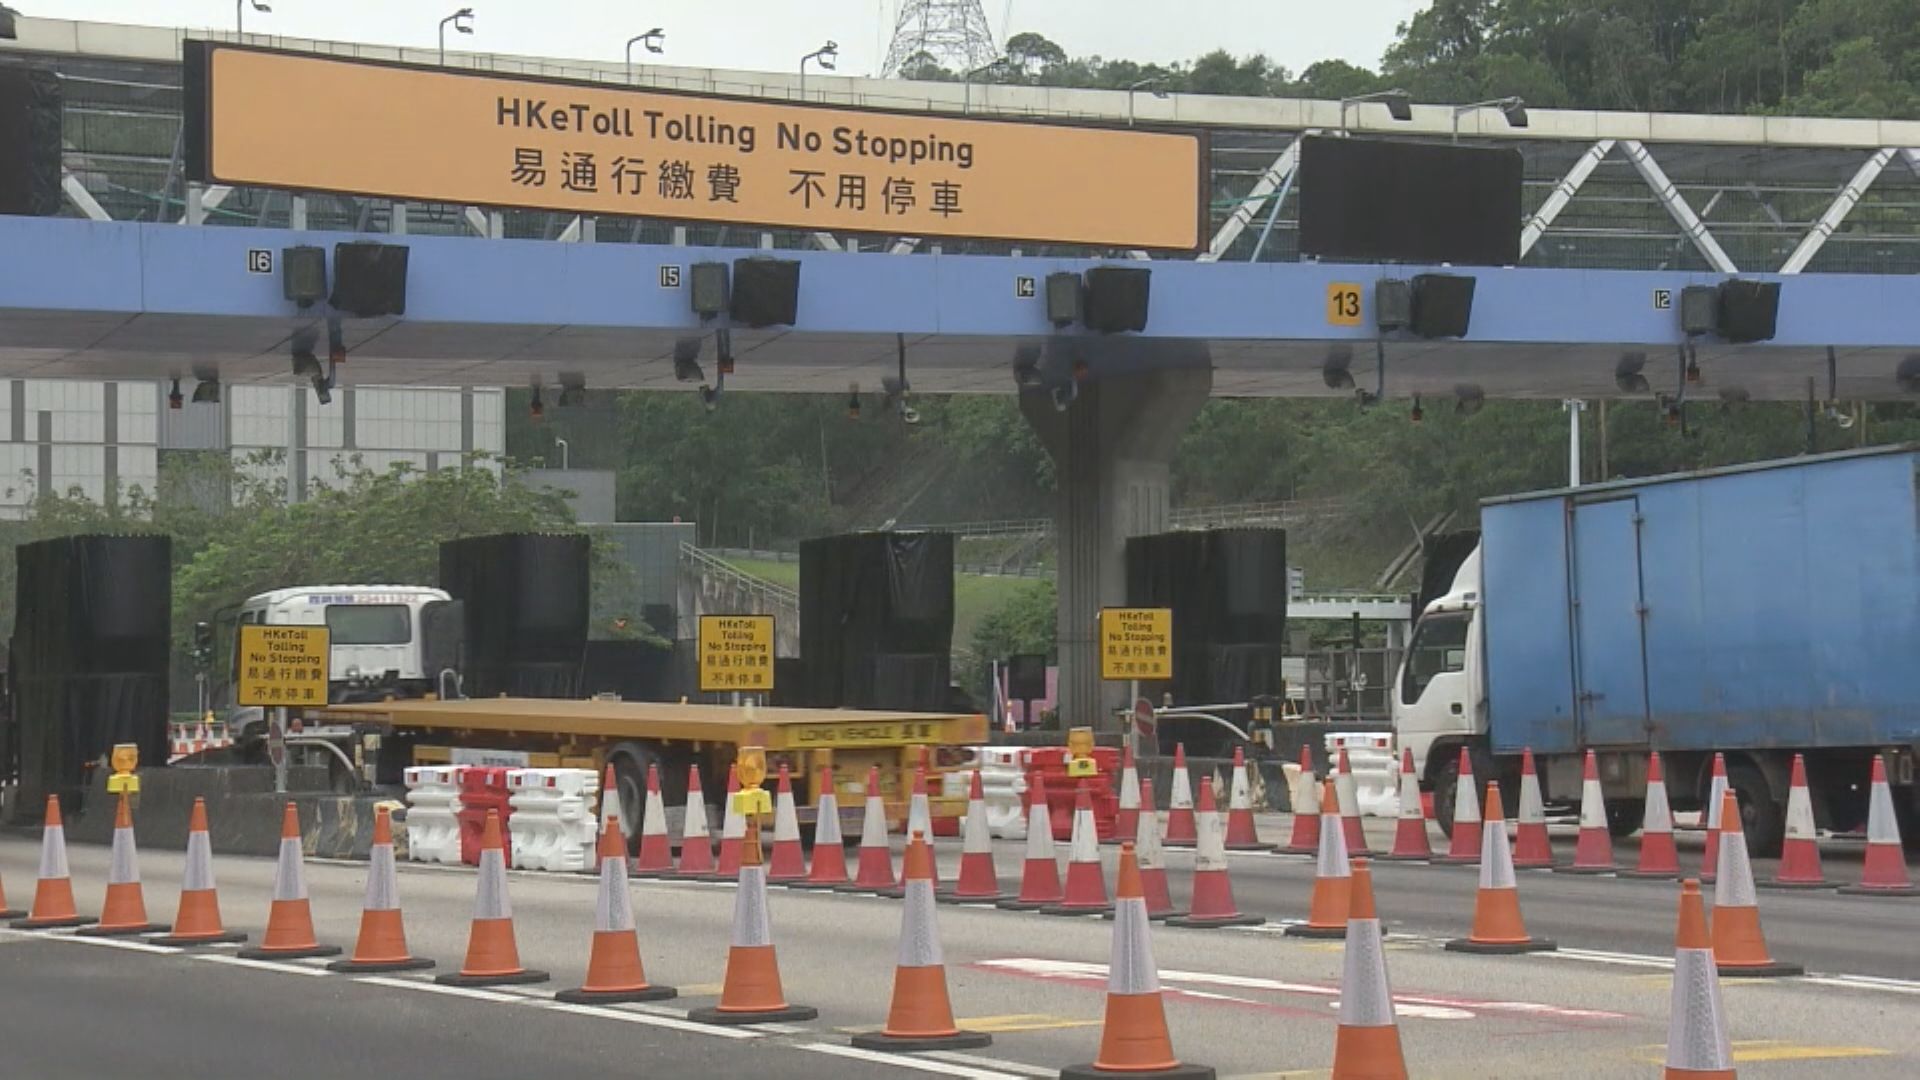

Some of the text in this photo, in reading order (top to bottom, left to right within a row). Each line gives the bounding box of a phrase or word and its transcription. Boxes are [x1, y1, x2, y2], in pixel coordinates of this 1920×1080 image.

[497, 96, 973, 169] HKeToll Tolling No Stopping
[511, 147, 963, 218] 易通行繳費 不用停車
[251, 251, 271, 270] 16
[662, 267, 679, 285] 15
[1019, 279, 1033, 295] 14
[1333, 291, 1359, 317] 13
[1656, 291, 1671, 308] 12
[263, 629, 308, 640] HKeToll
[1109, 632, 1121, 641] No
[268, 641, 305, 653] Tolling
[708, 642, 721, 651] No
[250, 652, 320, 665] No Stopping
